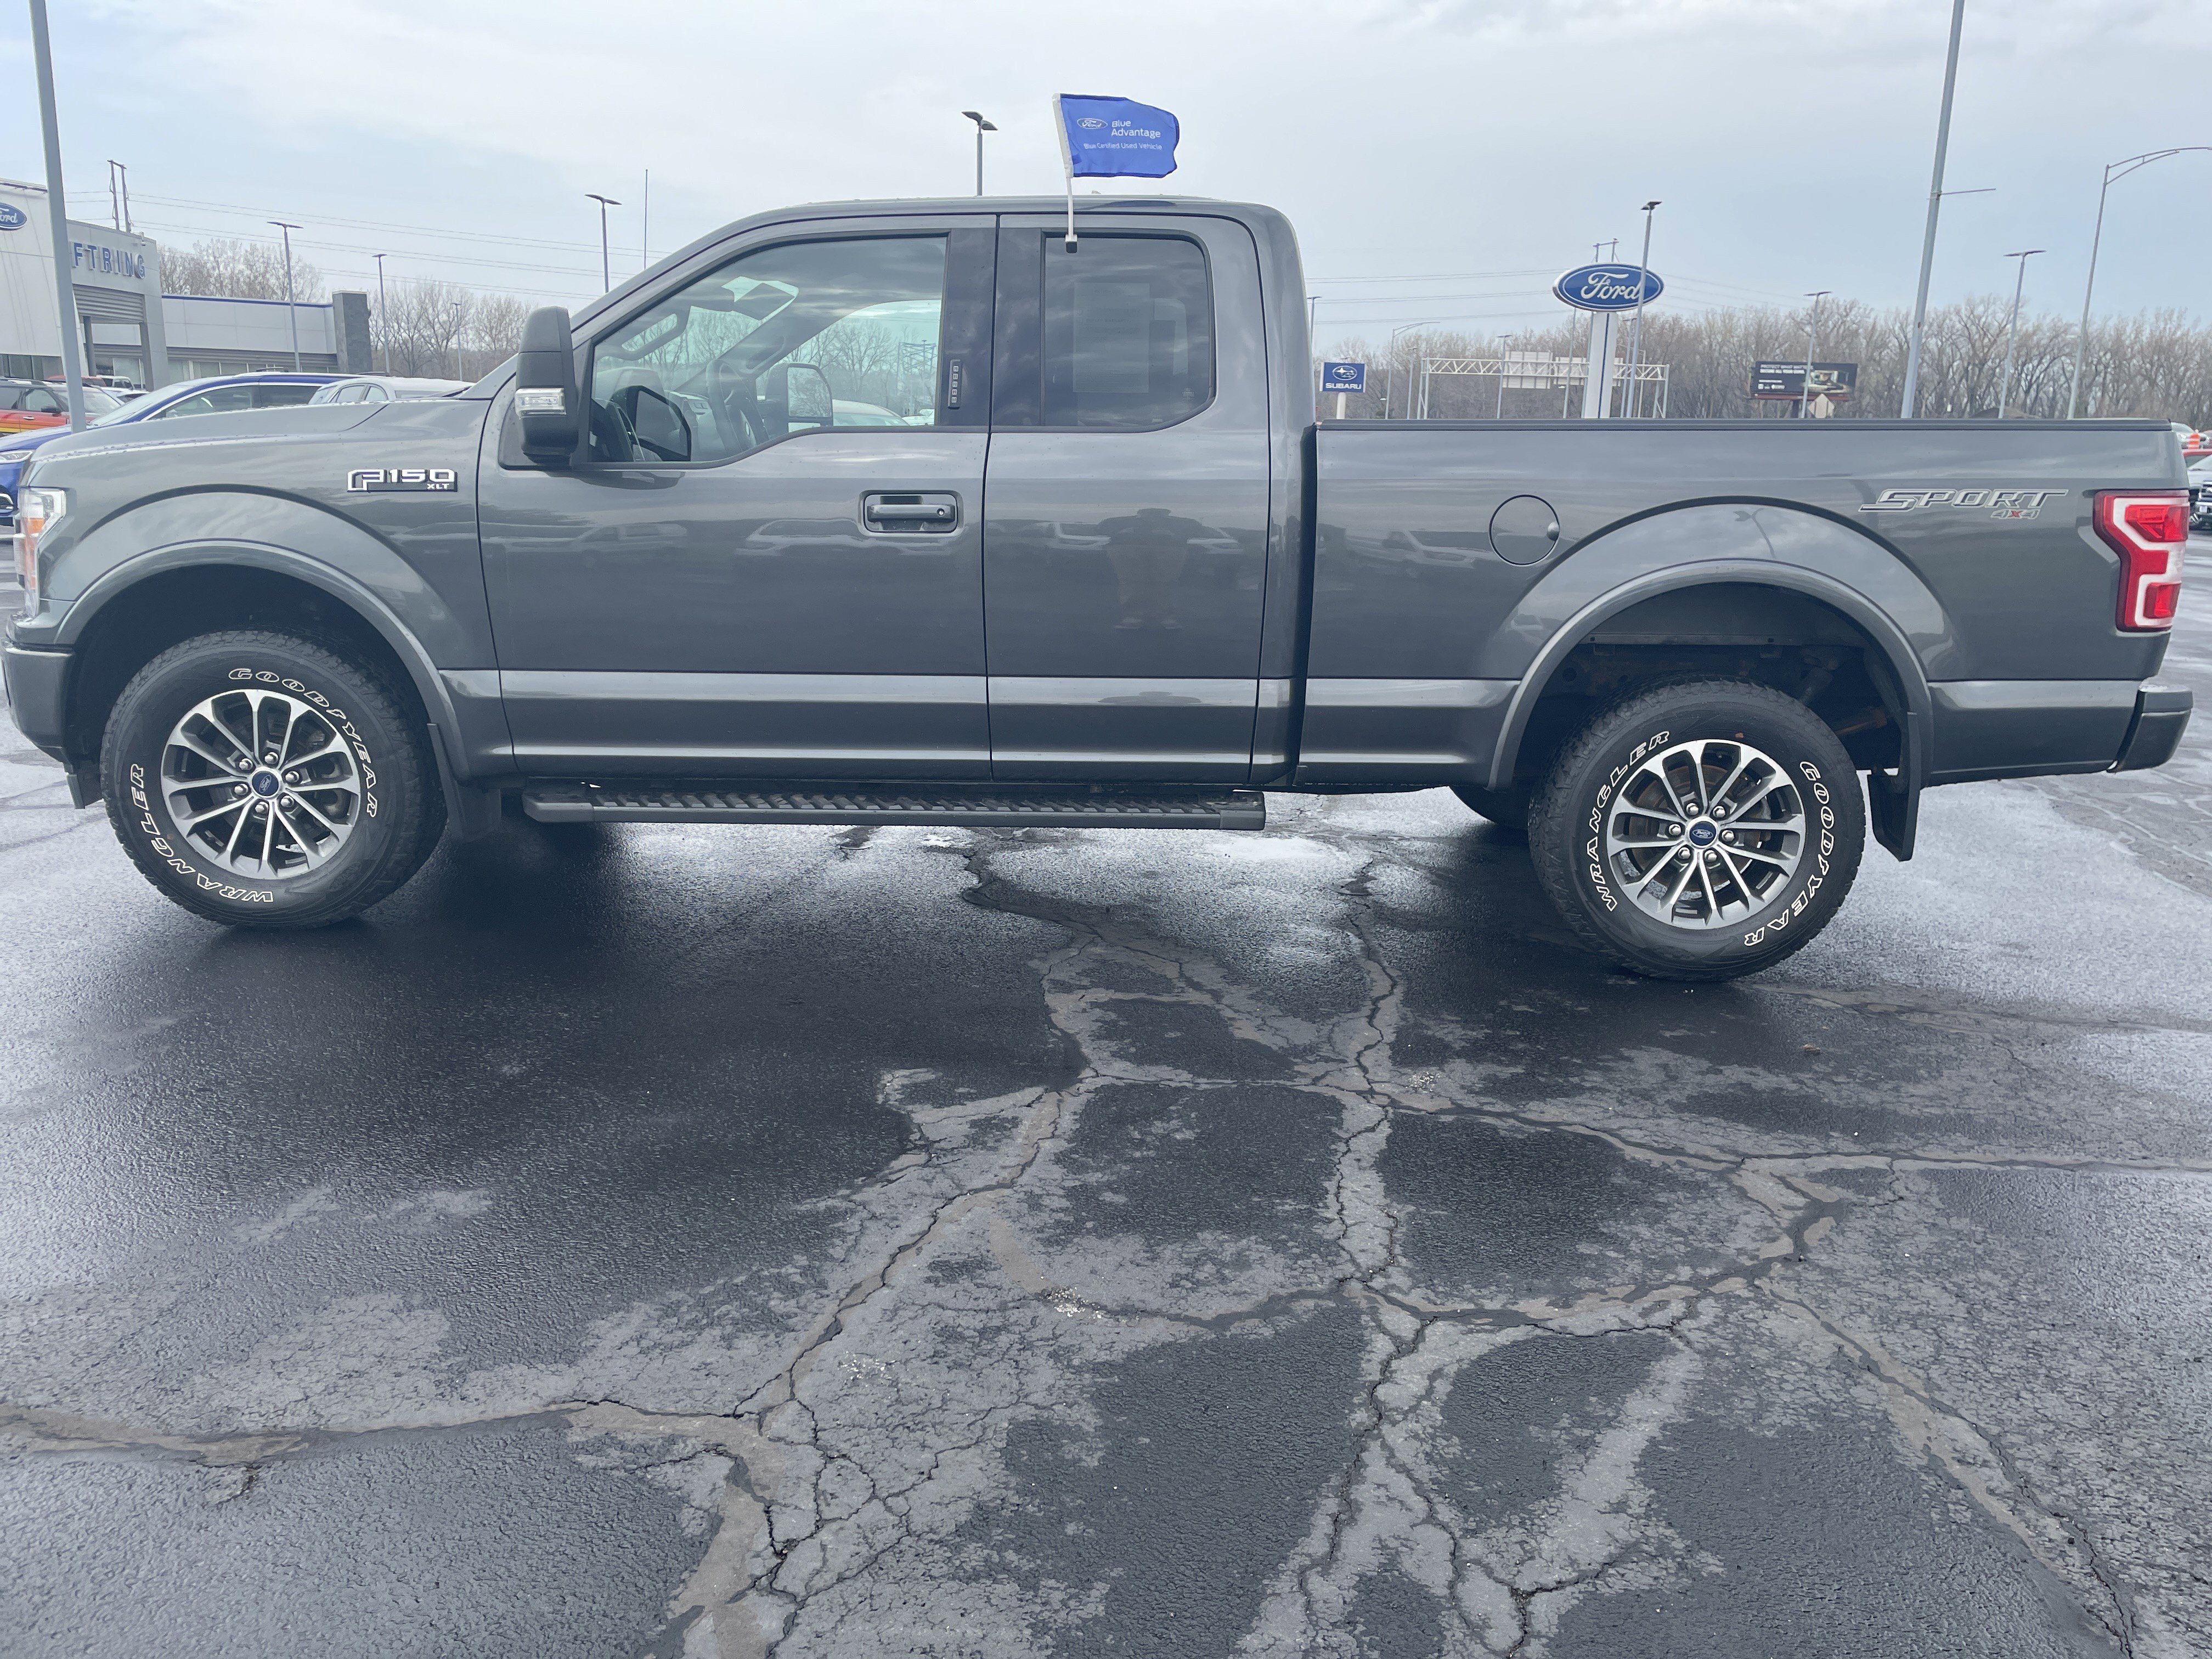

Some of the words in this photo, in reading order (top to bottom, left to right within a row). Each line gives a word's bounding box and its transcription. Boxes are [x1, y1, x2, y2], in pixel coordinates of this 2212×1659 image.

[1111, 128, 1161, 139] Advantage
[70, 241, 146, 279] FTRING
[1581, 272, 1642, 300] Ford
[347, 469, 455, 491] F150
[1858, 488, 2069, 512] SPORT
[228, 668, 377, 817] GOODYEAR
[130, 763, 274, 902] WRANGLER
[1587, 731, 1670, 912] WRANGLER
[1744, 761, 1835, 946] GOODYEAR
